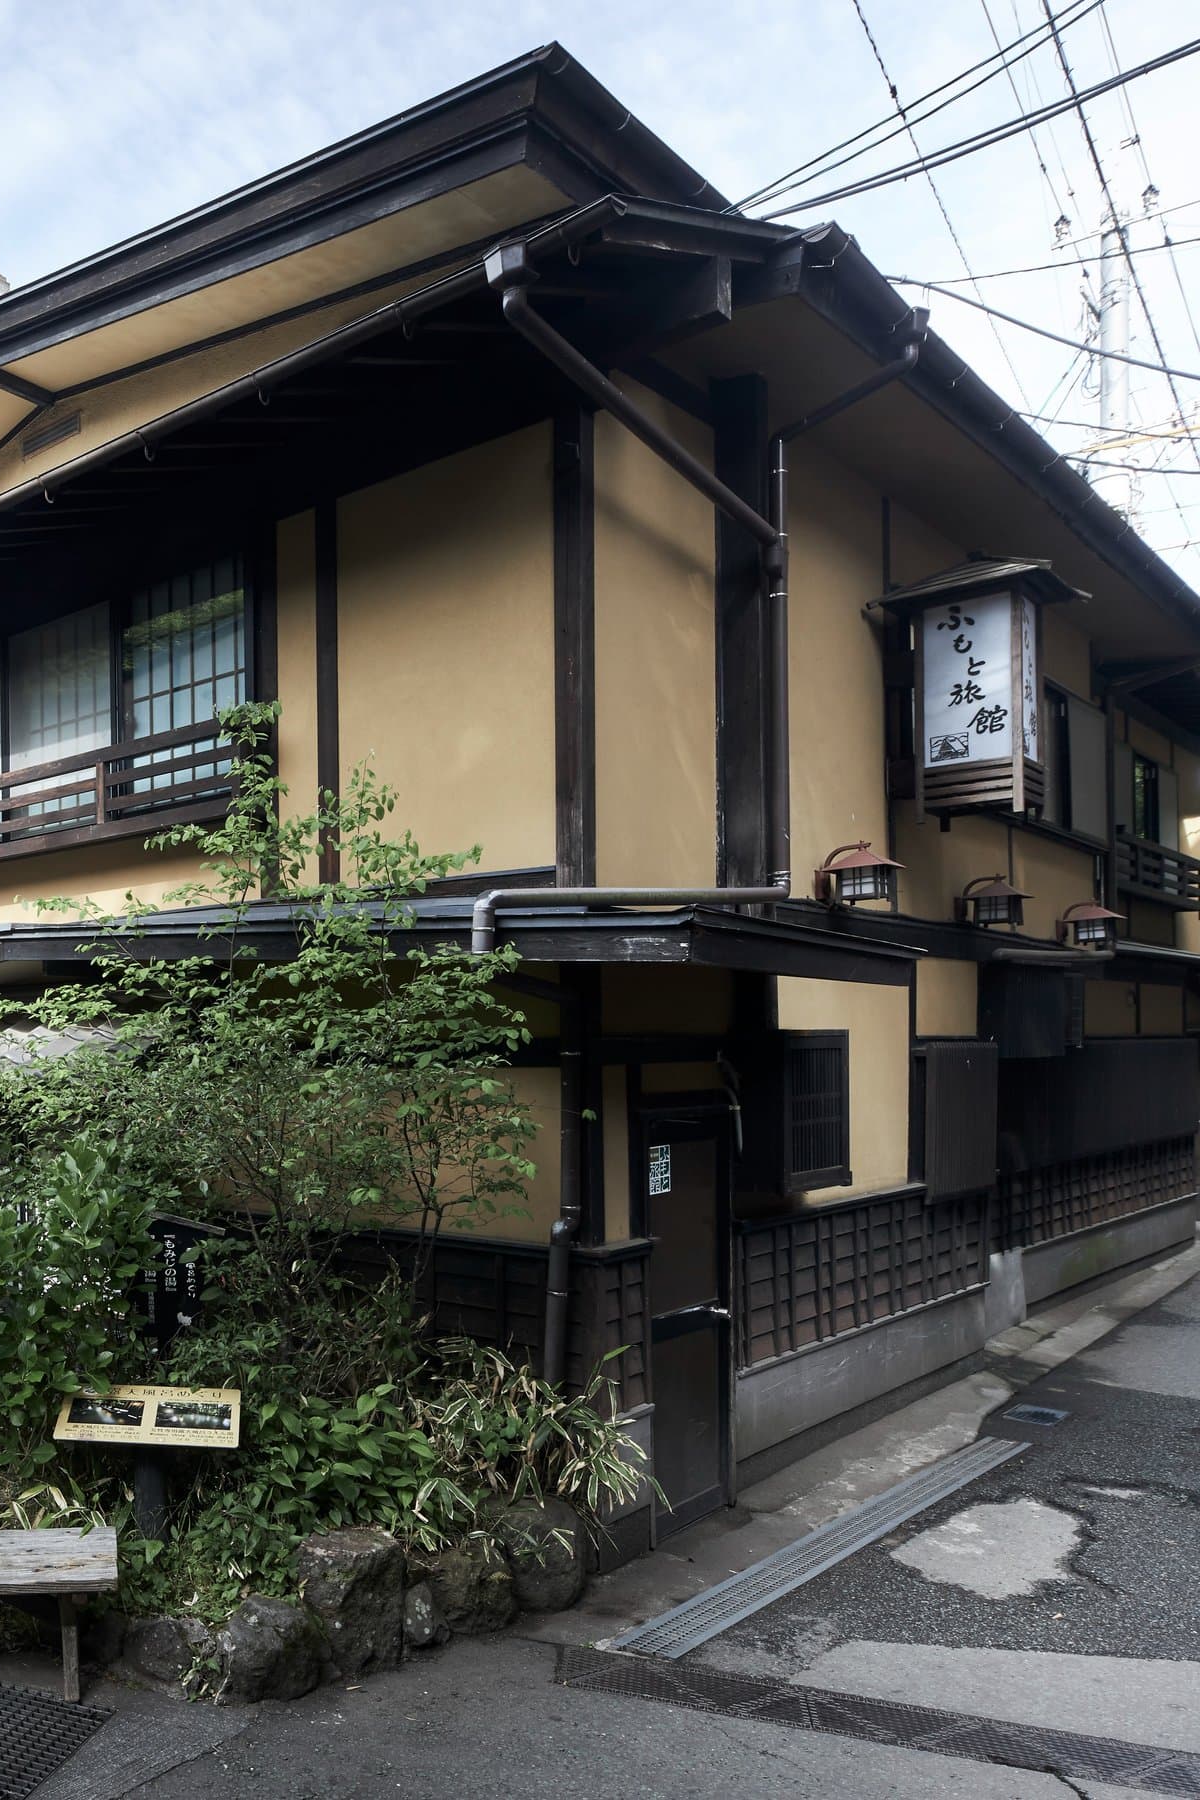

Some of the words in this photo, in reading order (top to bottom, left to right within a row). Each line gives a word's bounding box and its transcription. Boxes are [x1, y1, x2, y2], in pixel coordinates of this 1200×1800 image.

[937, 605, 1008, 734] ふもと旅館
